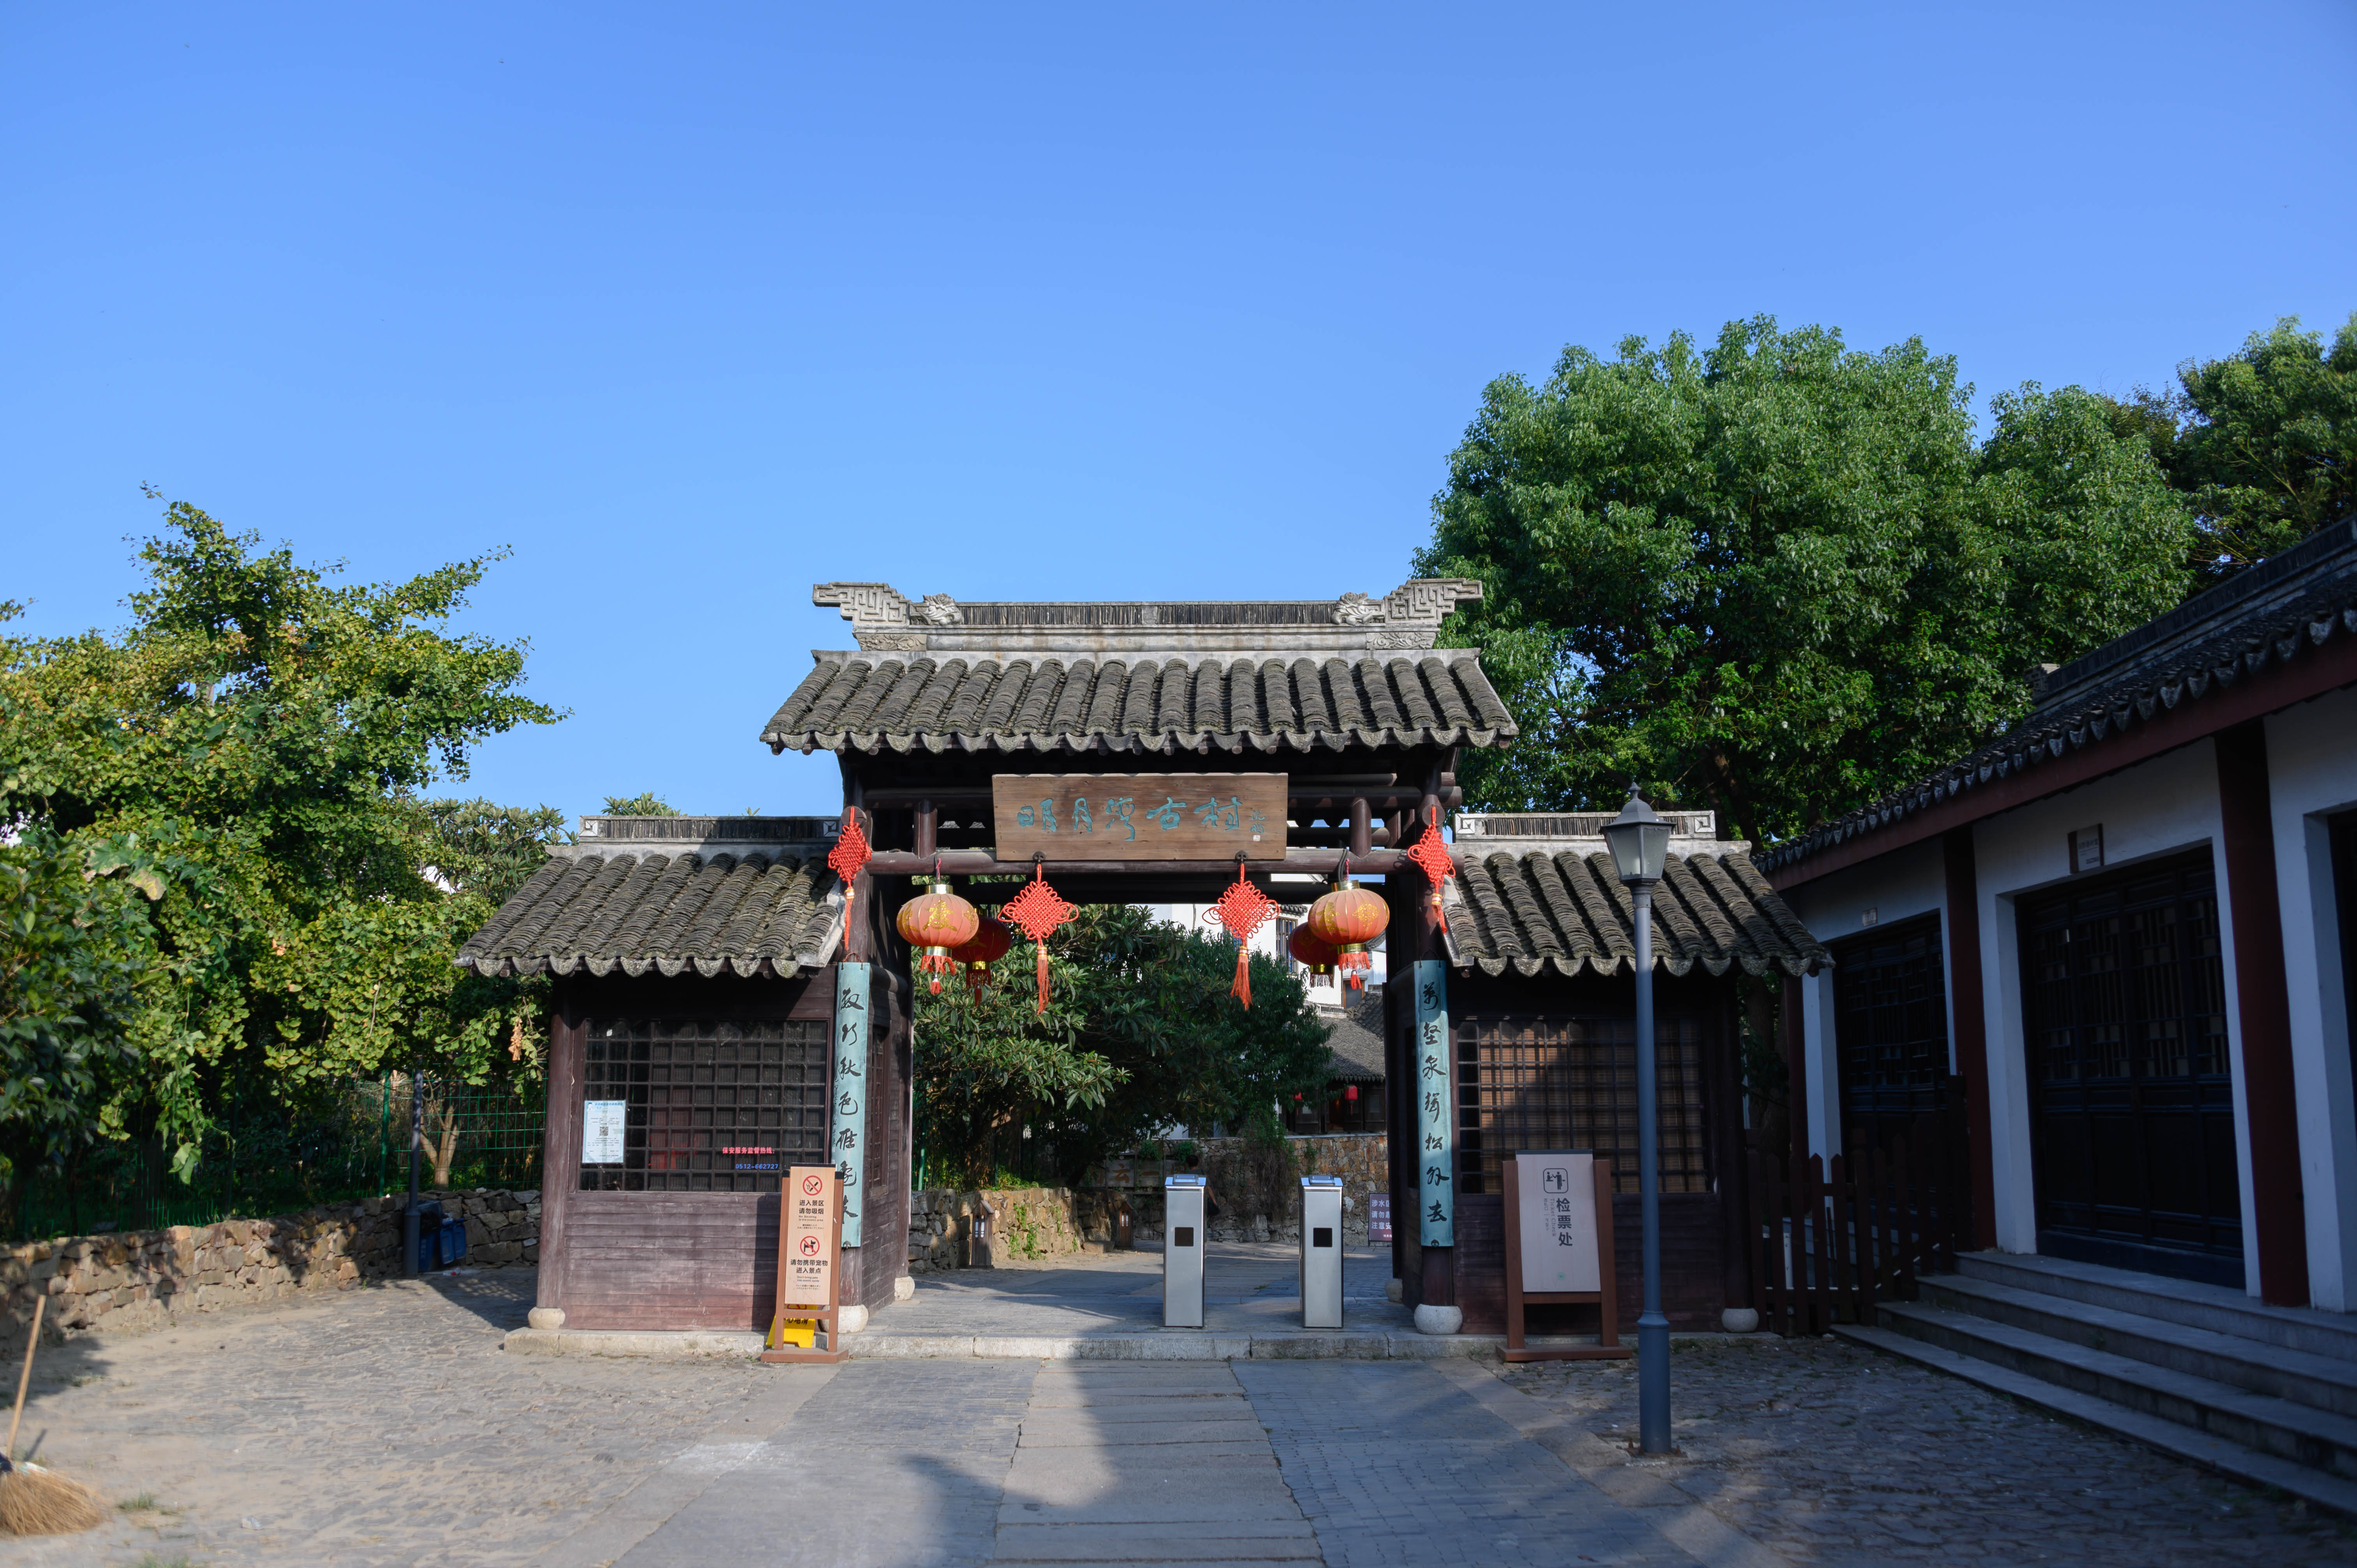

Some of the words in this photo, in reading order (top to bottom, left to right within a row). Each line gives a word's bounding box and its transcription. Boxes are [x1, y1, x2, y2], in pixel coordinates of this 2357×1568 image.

[1371, 1222, 1392, 1230] 注意安
[1556, 1197, 1573, 1247] 检票处
